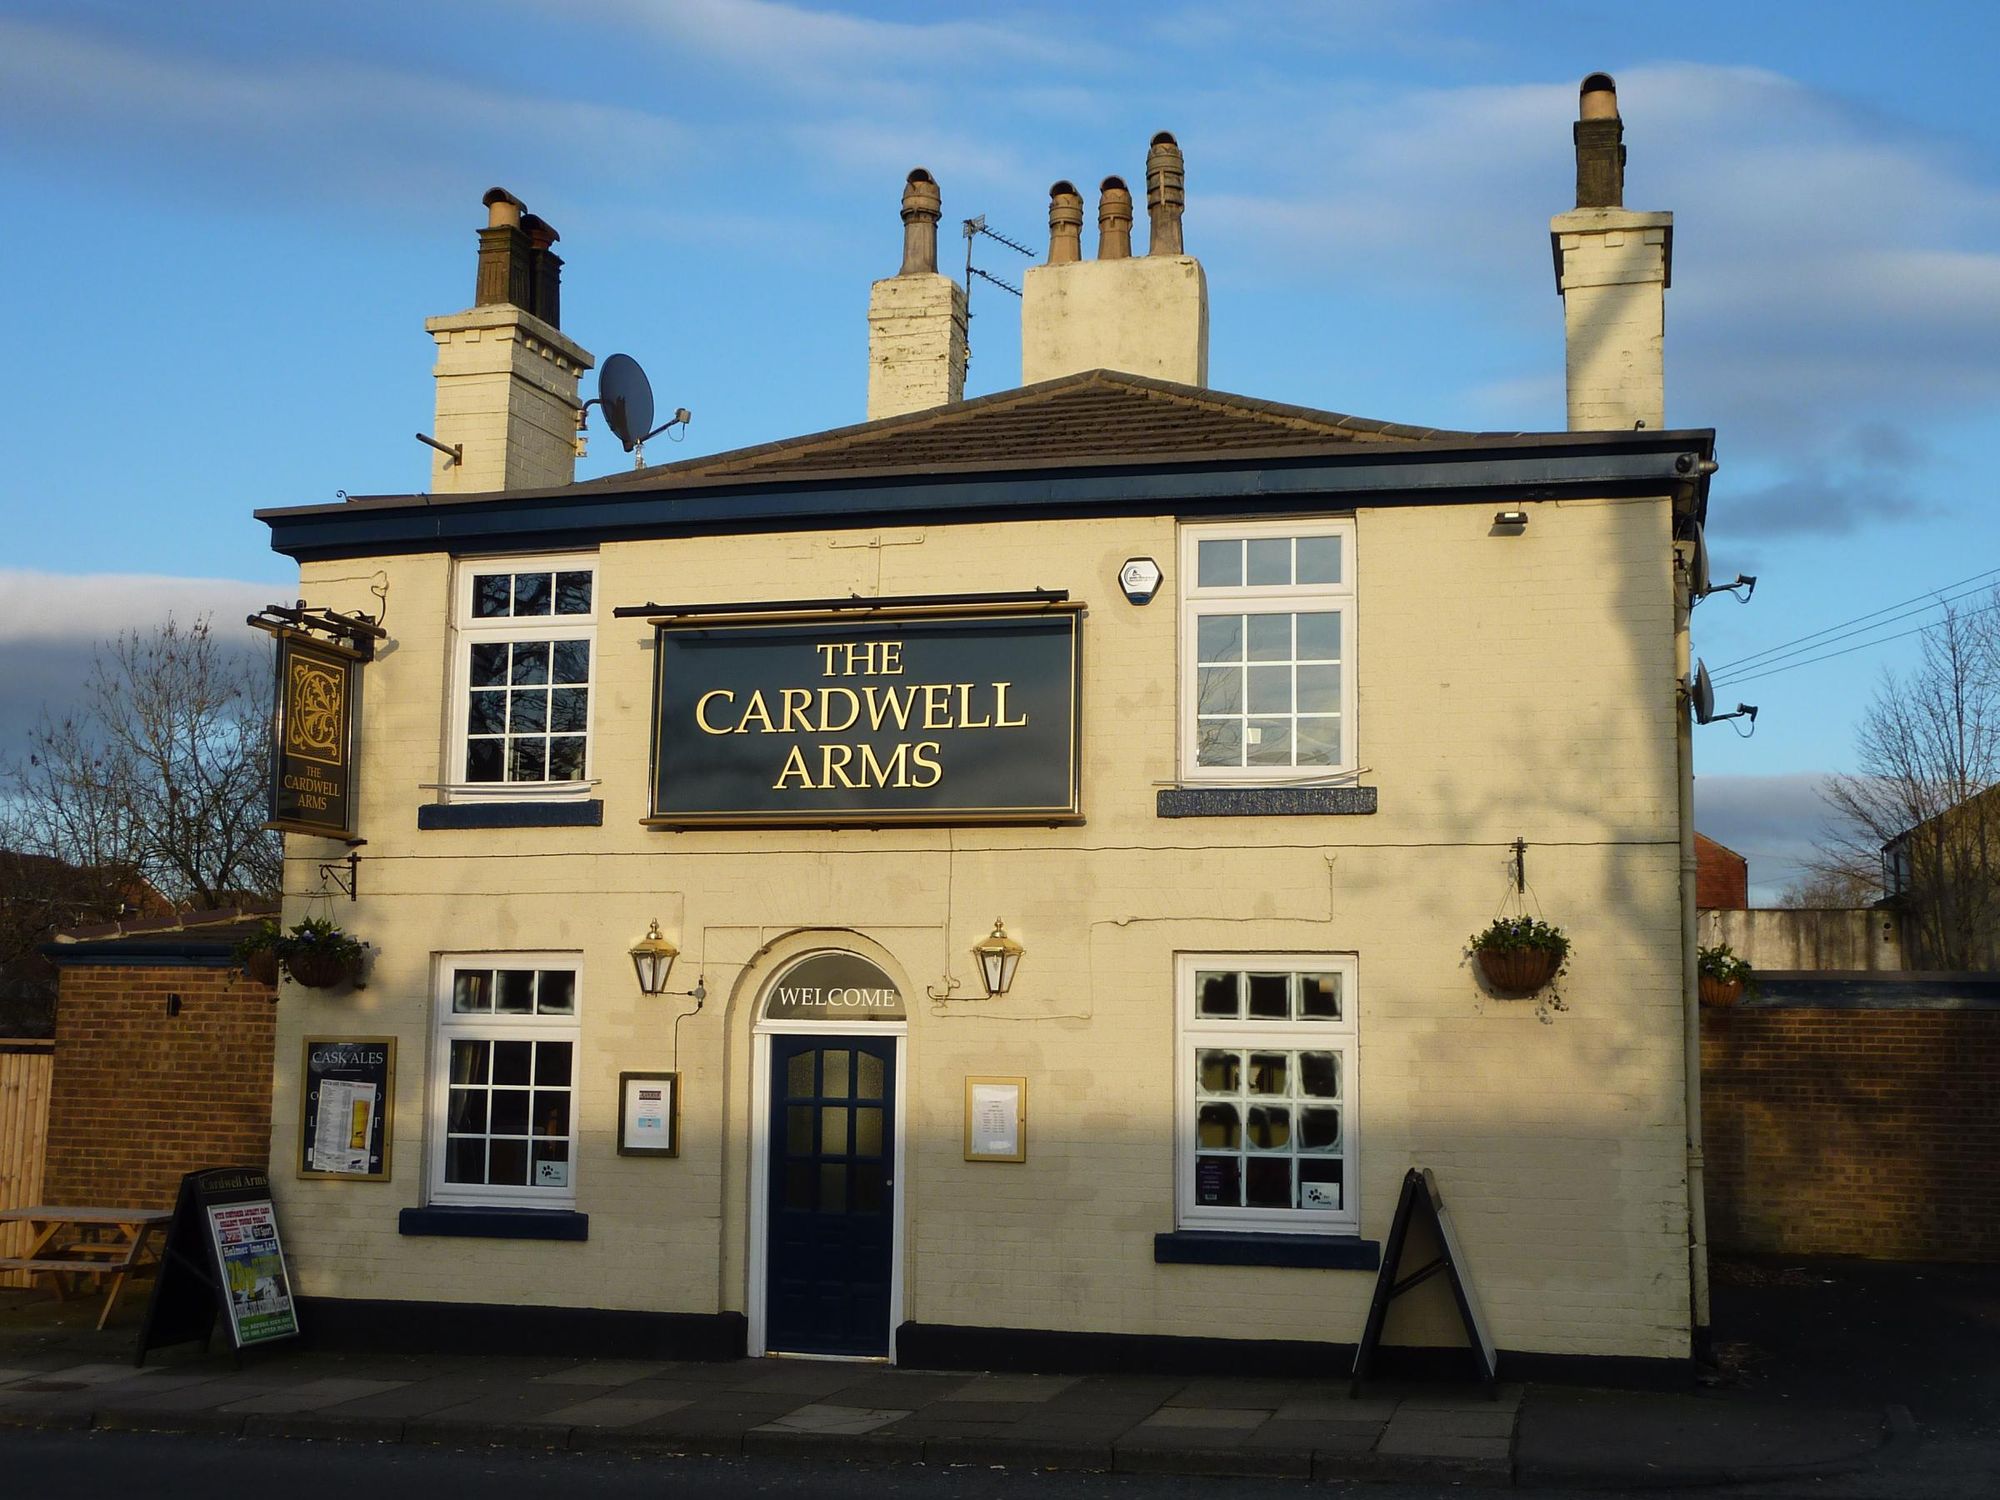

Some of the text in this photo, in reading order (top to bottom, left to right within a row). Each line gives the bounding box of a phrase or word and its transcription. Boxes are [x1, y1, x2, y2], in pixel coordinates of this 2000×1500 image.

[817, 641, 904, 677] THE
[695, 682, 1029, 736] CARDWELL
[306, 766, 321, 778] THE
[772, 741, 944, 790] ARMS
[284, 774, 340, 797] CARDWELL
[298, 793, 327, 810] ARMS
[779, 987, 896, 1007] WELCOME
[312, 1051, 384, 1064] CASK ALES
[202, 1175, 267, 1191] Cardwell Arms
